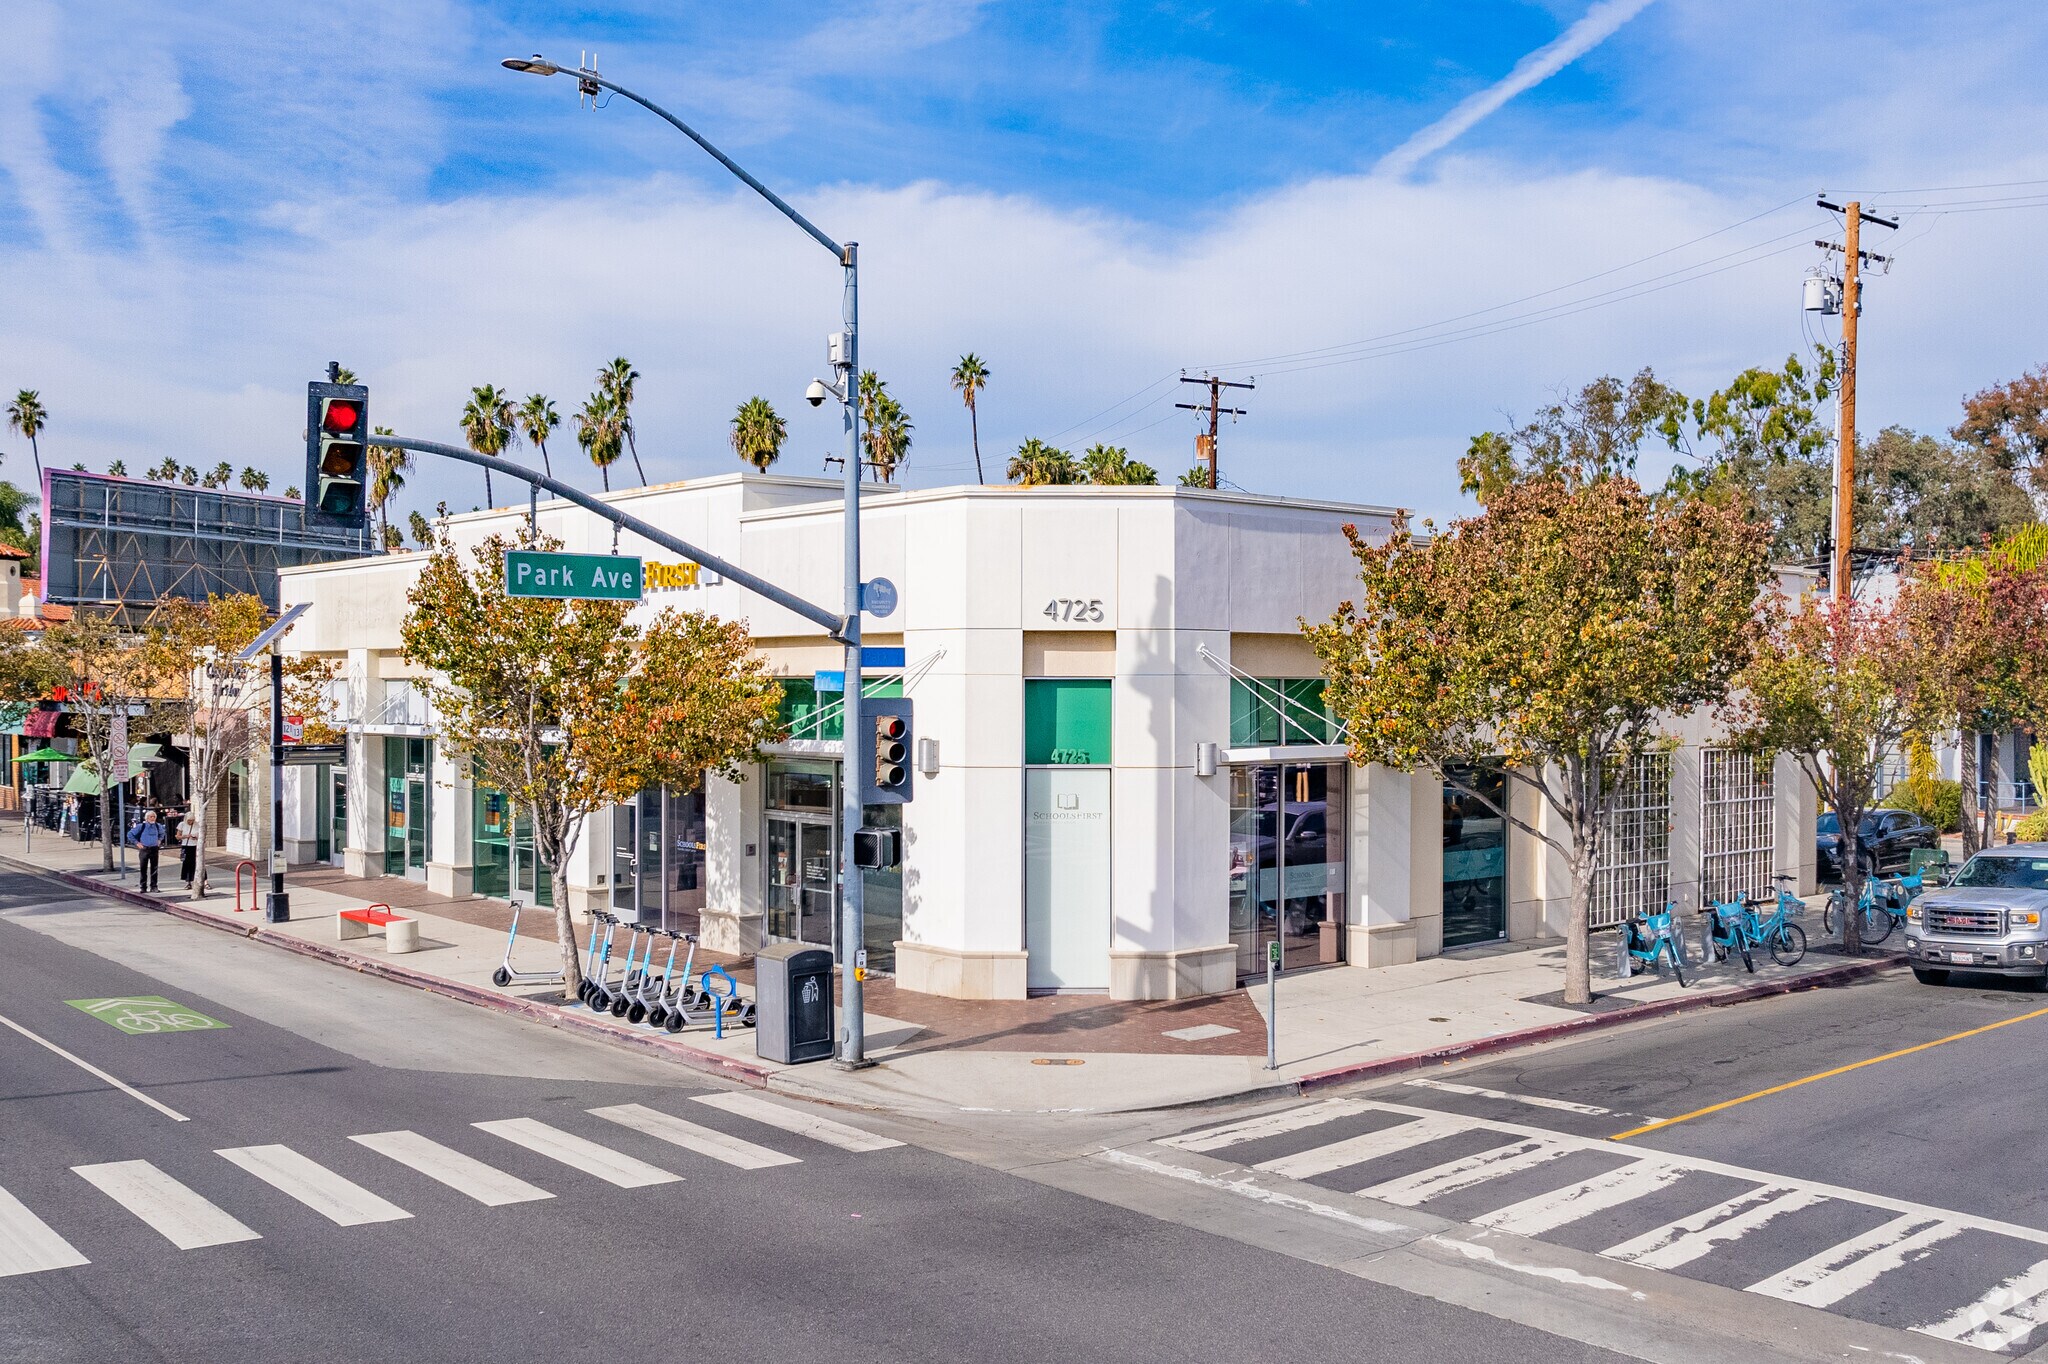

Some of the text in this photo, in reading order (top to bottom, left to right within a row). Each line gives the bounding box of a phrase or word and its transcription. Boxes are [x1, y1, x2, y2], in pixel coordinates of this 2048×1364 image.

[517, 562, 633, 589] Park Ave
[1043, 598, 1104, 623] 4725
[1051, 748, 1088, 764] 4725
[1033, 811, 1103, 820] SCHOOLSFIRST
[1946, 916, 1978, 925] GMC
